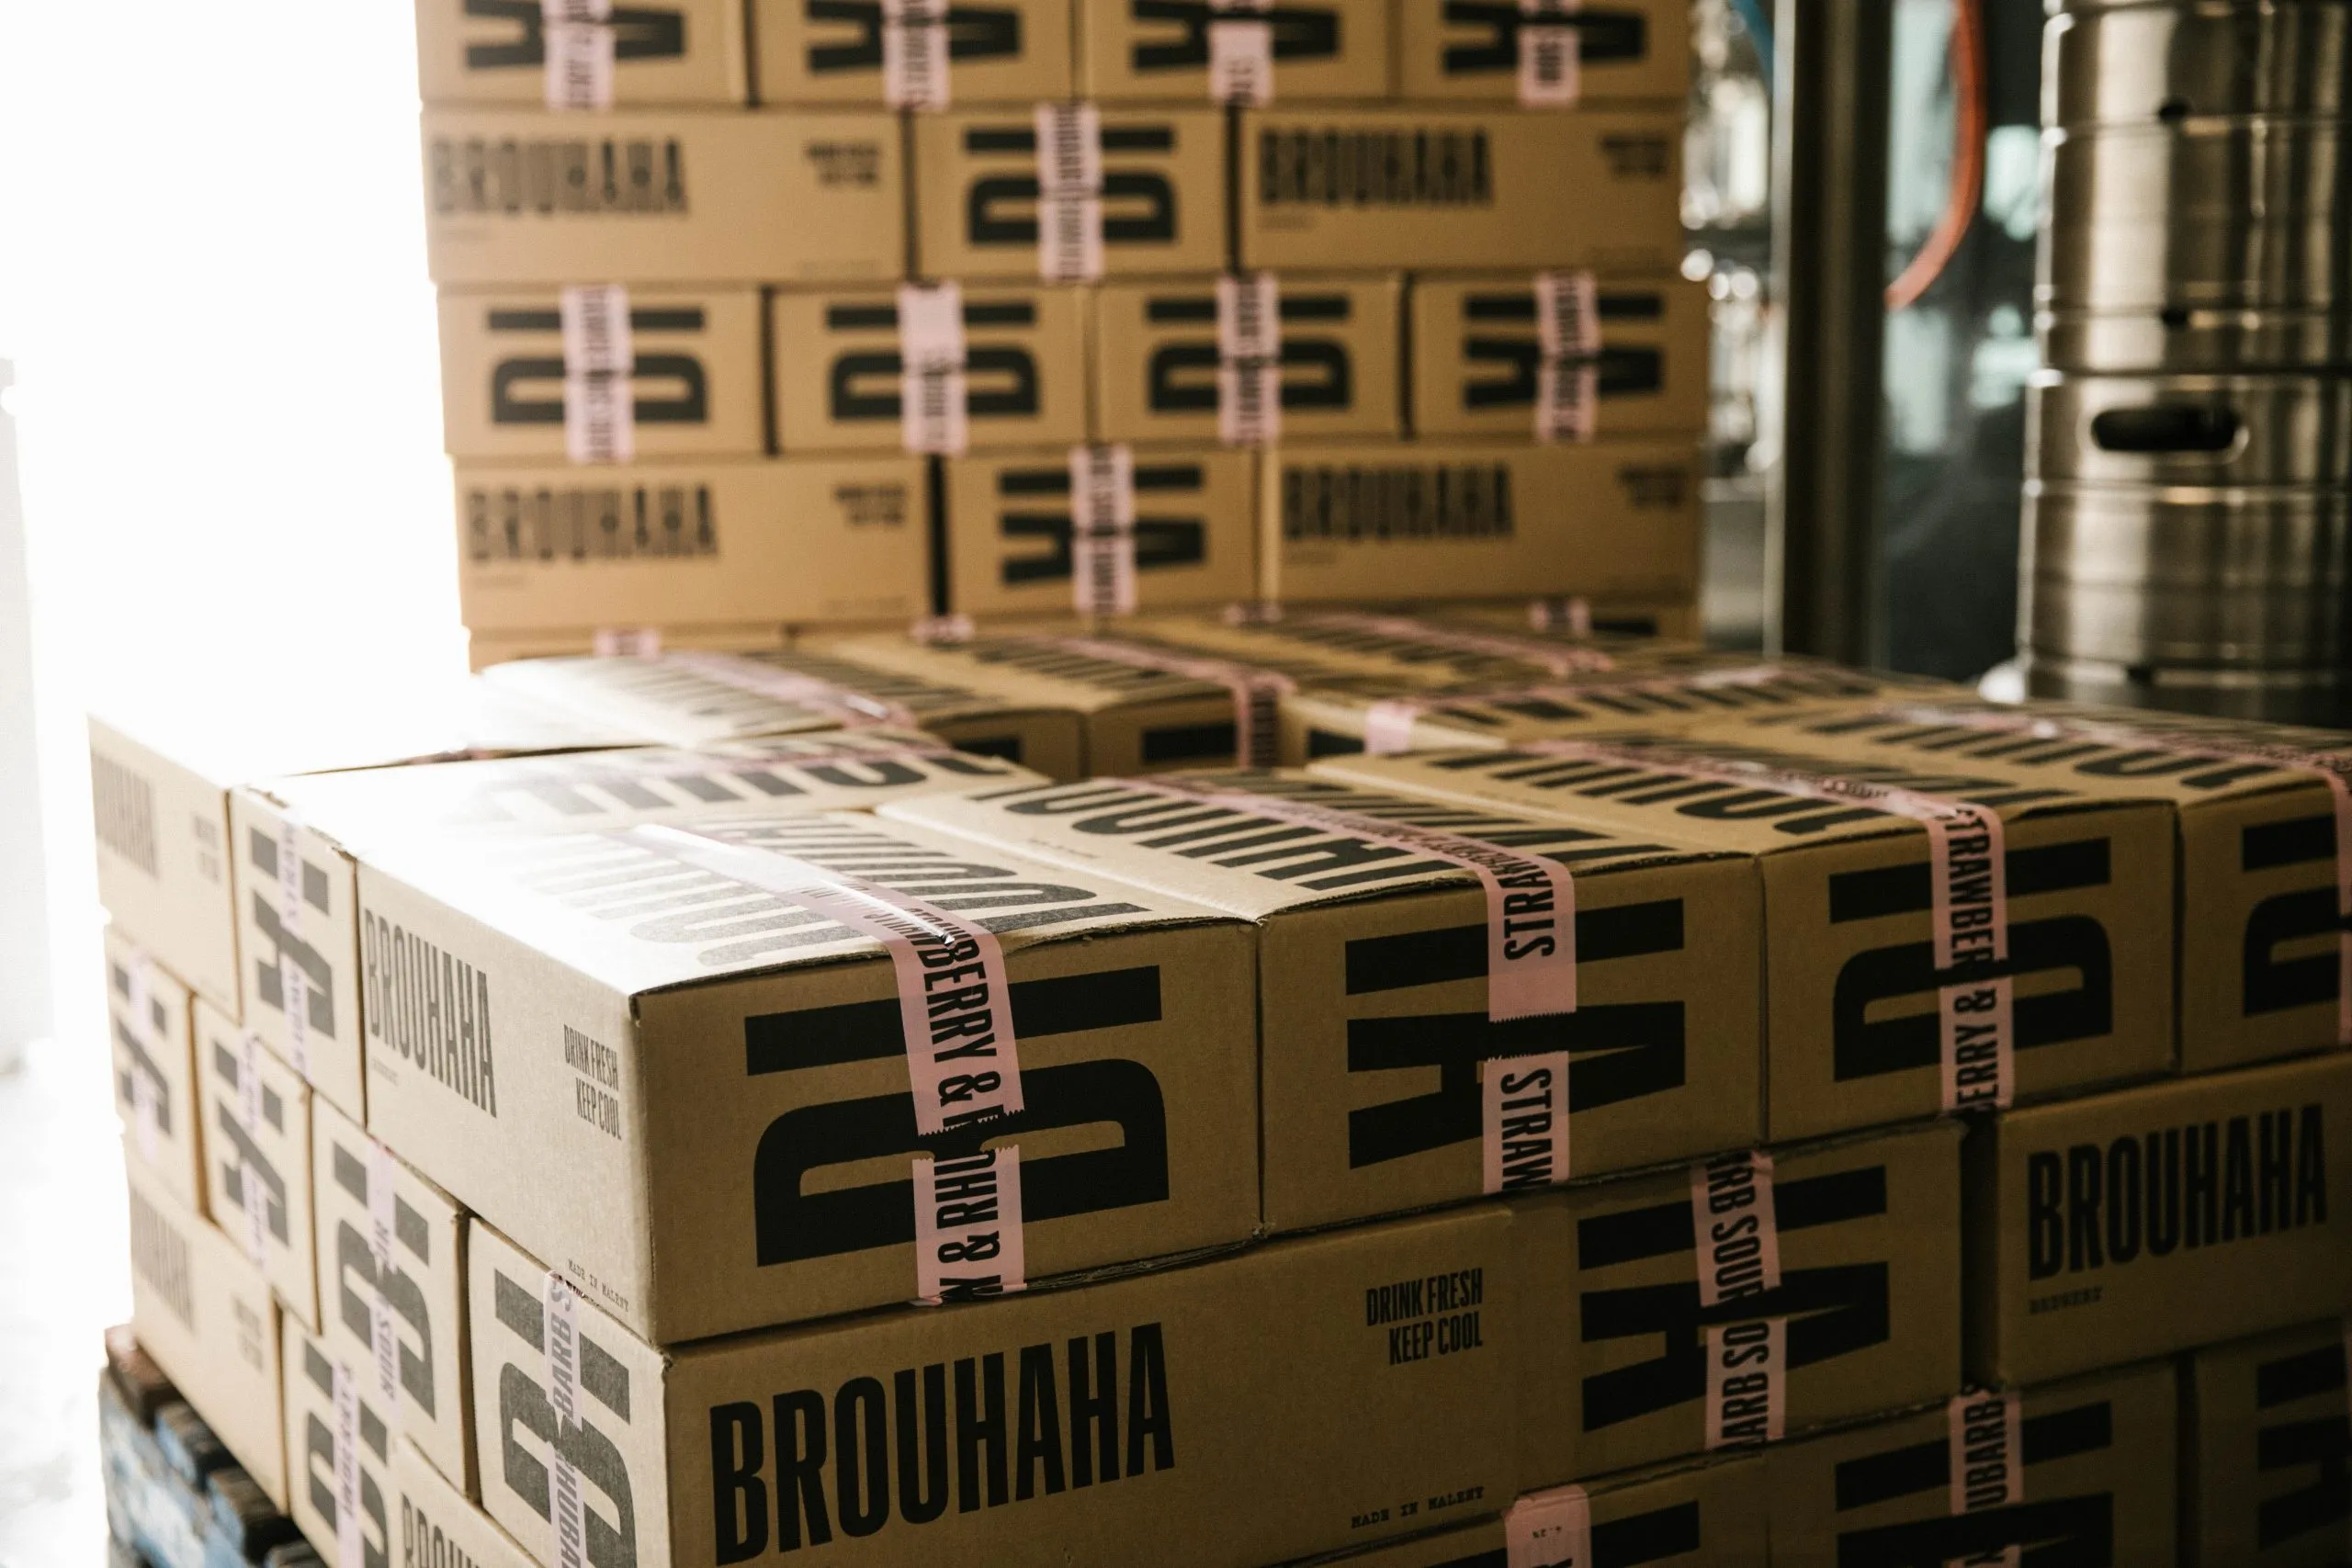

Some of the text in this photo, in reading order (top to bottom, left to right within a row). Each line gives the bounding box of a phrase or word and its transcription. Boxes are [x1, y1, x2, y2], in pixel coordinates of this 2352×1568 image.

[365, 907, 497, 1119] BROUHAHA
[563, 1023, 618, 1092] DRINK FRESH
[575, 1077, 621, 1141] KEEP COOL
[2029, 1104, 2327, 1281] BROUHAHA
[1366, 1268, 1483, 1326] DRINK FRESH
[1388, 1311, 1483, 1366] KEEP COOL
[710, 1322, 1175, 1566] BROUHAHA
[1351, 1509, 1389, 1529] MADE
[1400, 1502, 1419, 1517] IN
